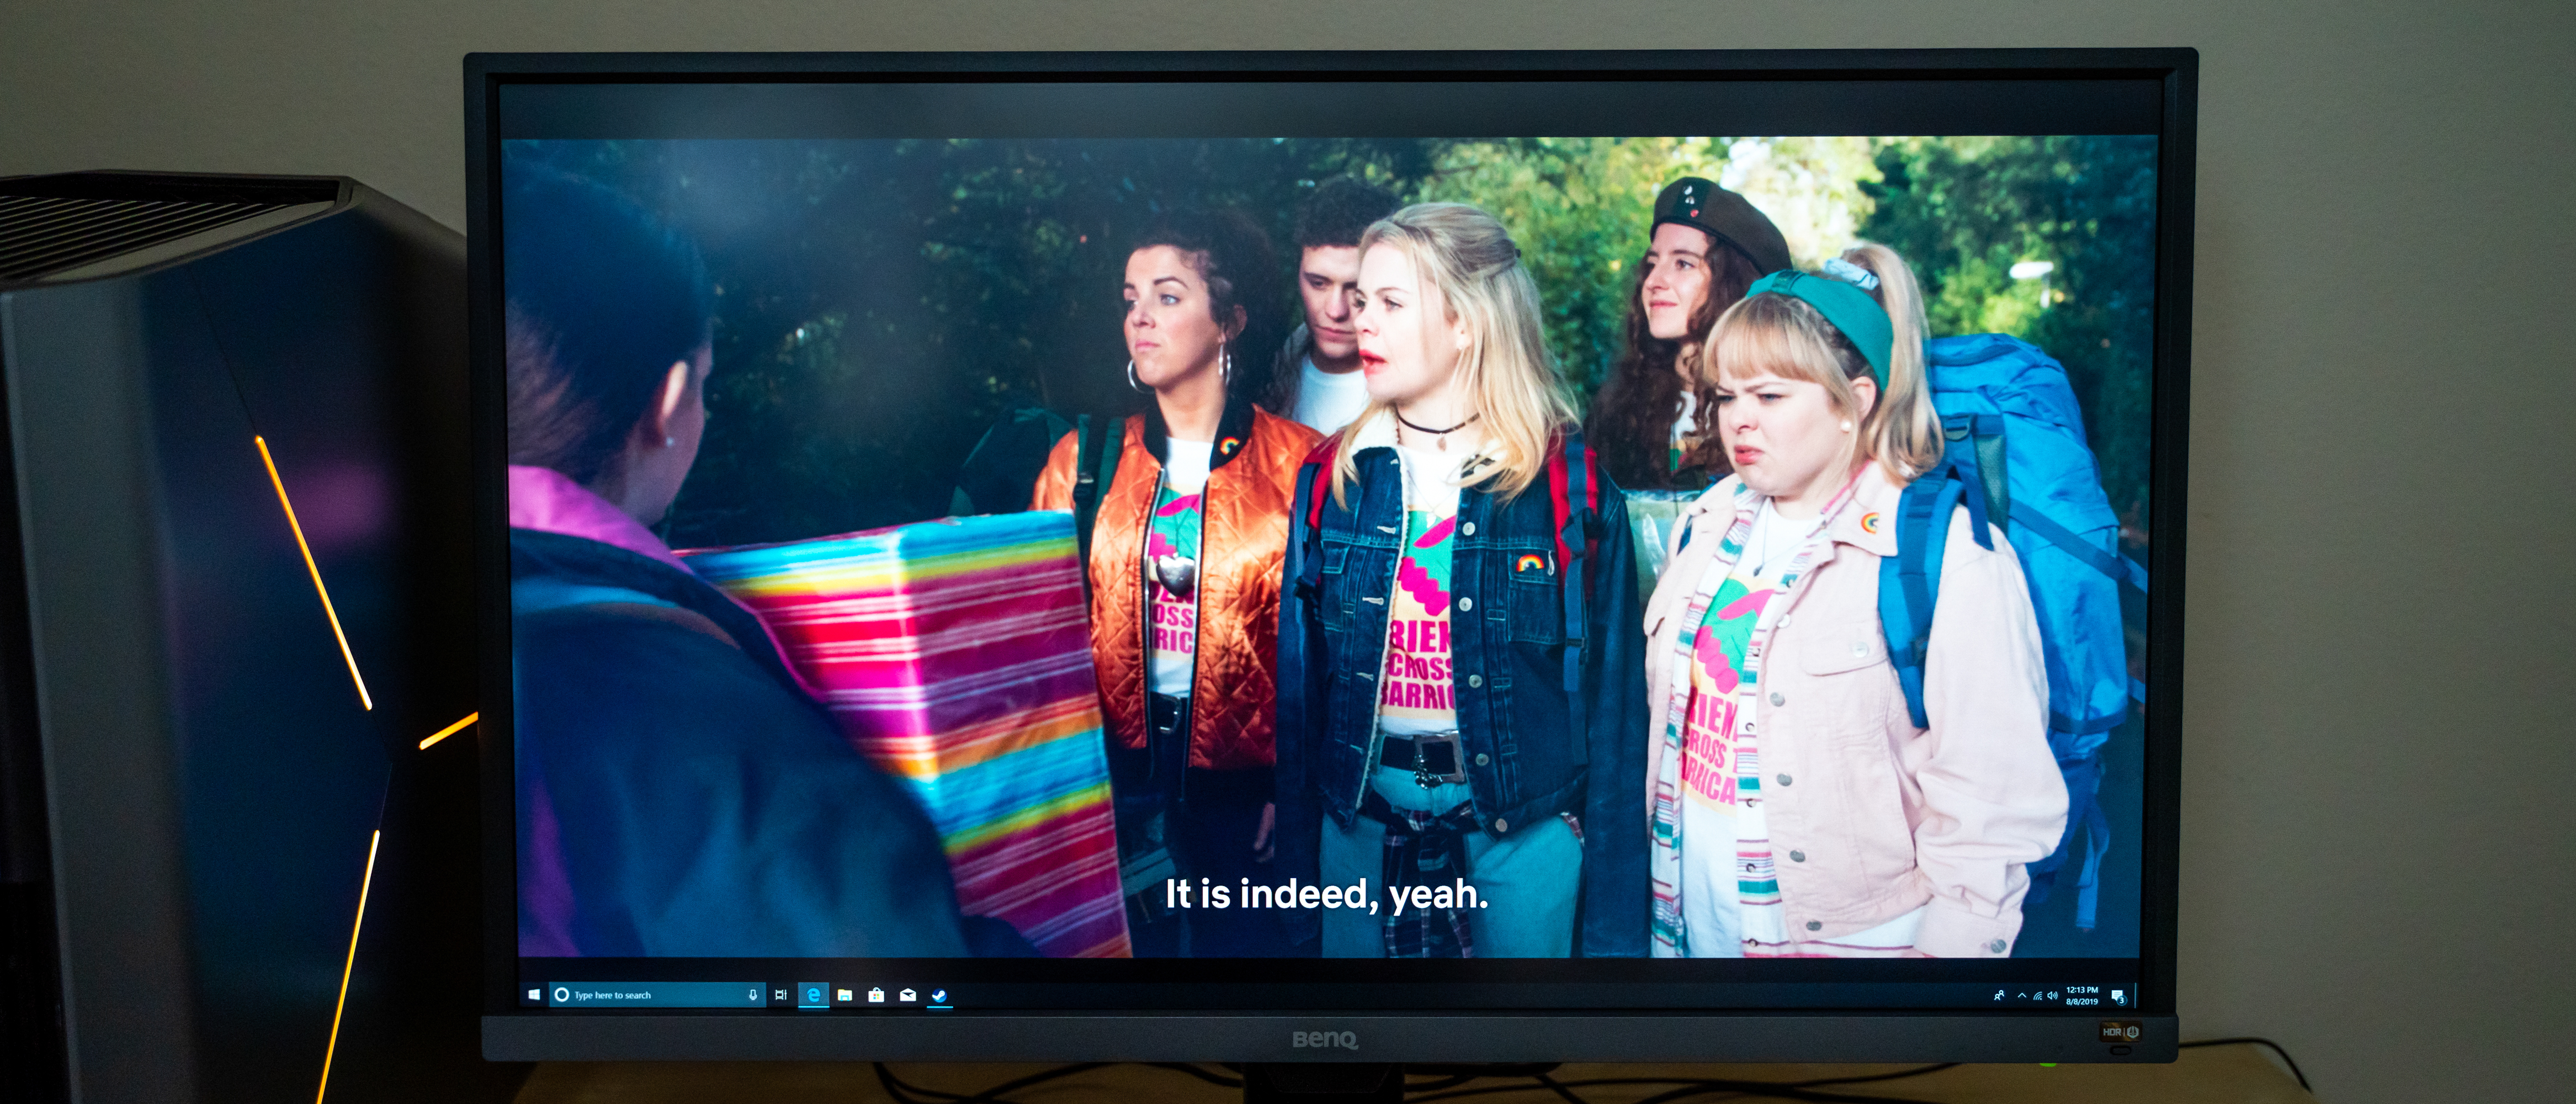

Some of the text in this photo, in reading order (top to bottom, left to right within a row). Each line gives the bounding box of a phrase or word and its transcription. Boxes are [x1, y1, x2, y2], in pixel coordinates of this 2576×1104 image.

[1149, 627, 1193, 654] RIC
[1683, 724, 1727, 768] ROSS
[1167, 878, 1488, 916] It is indeed, yeah.
[575, 991, 593, 1001] Type
[595, 991, 613, 999] here
[625, 991, 651, 999] search
[1293, 1031, 1359, 1050] BenQ
[2103, 1028, 2122, 1036] HDR
